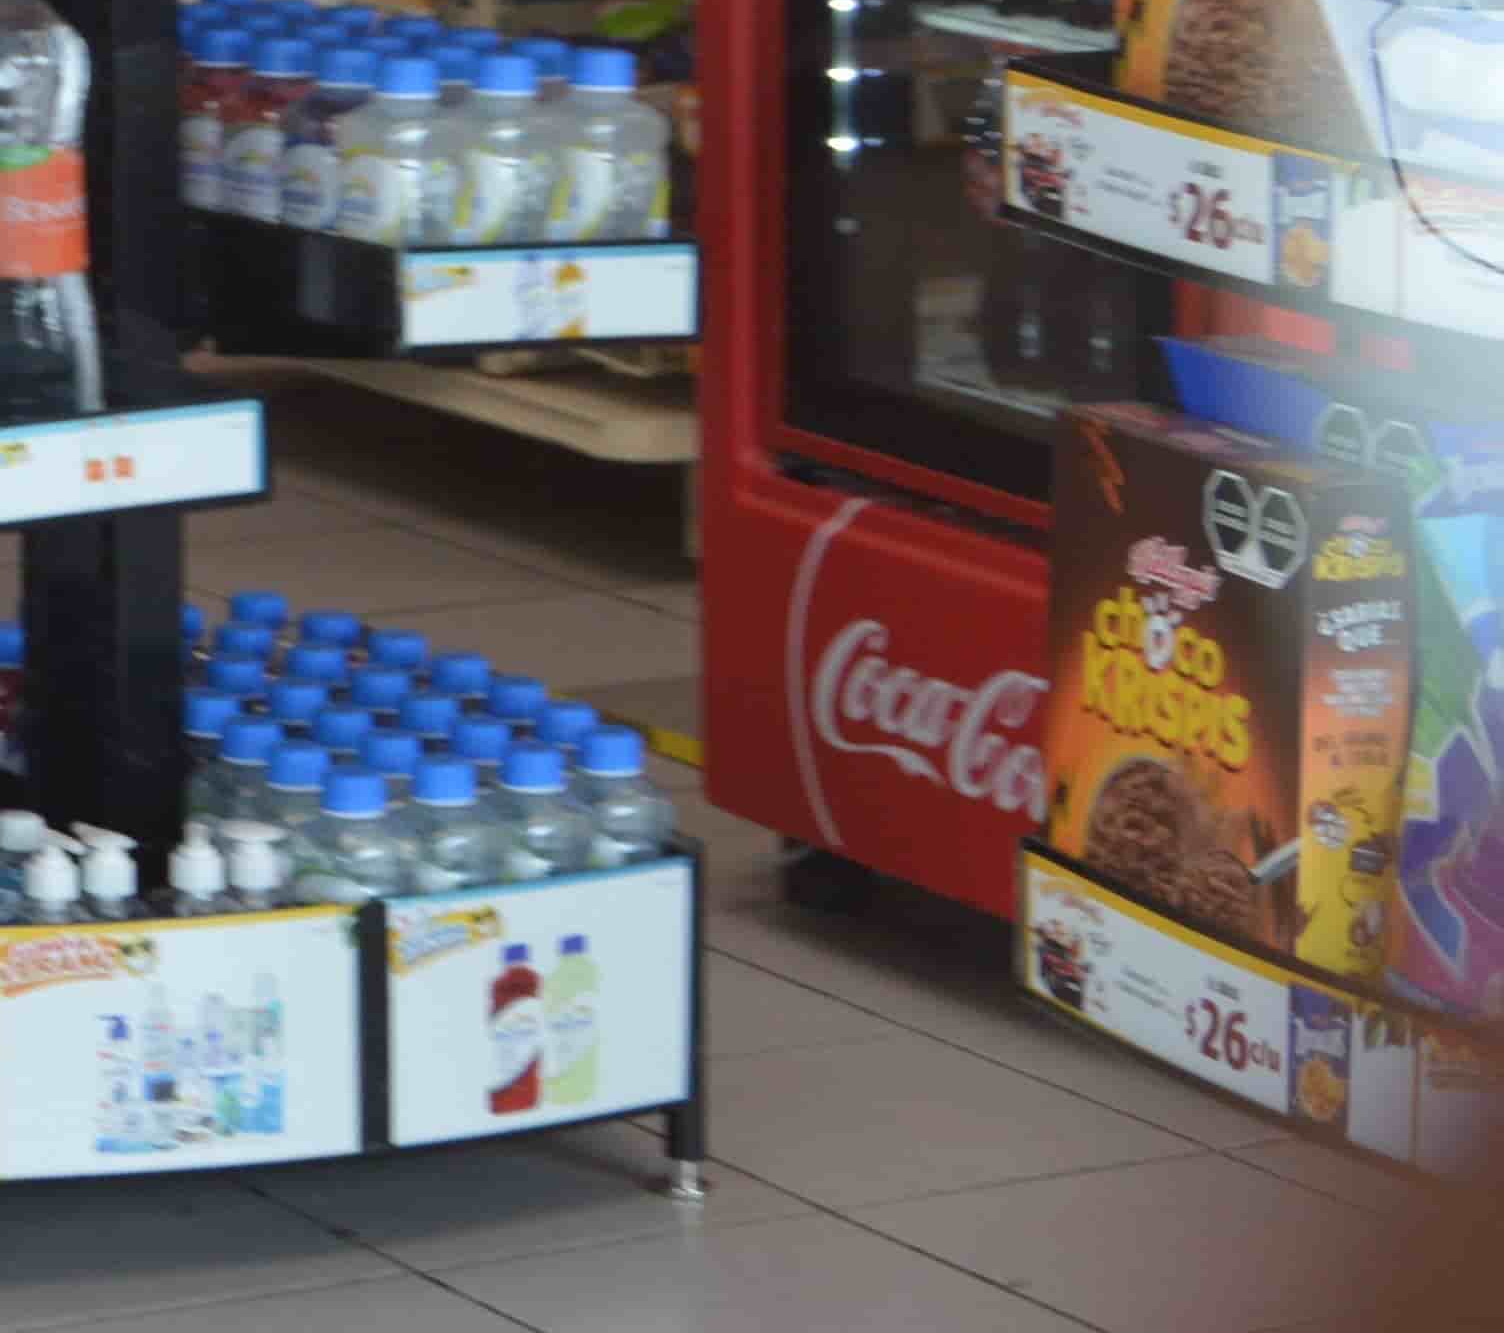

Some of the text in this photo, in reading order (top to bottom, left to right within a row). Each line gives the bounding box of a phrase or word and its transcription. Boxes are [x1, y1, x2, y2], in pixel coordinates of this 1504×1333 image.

[1167, 185, 1233, 249] $26
[1082, 630, 1253, 771] KRISPIS
[1183, 996, 1250, 1071] $26
